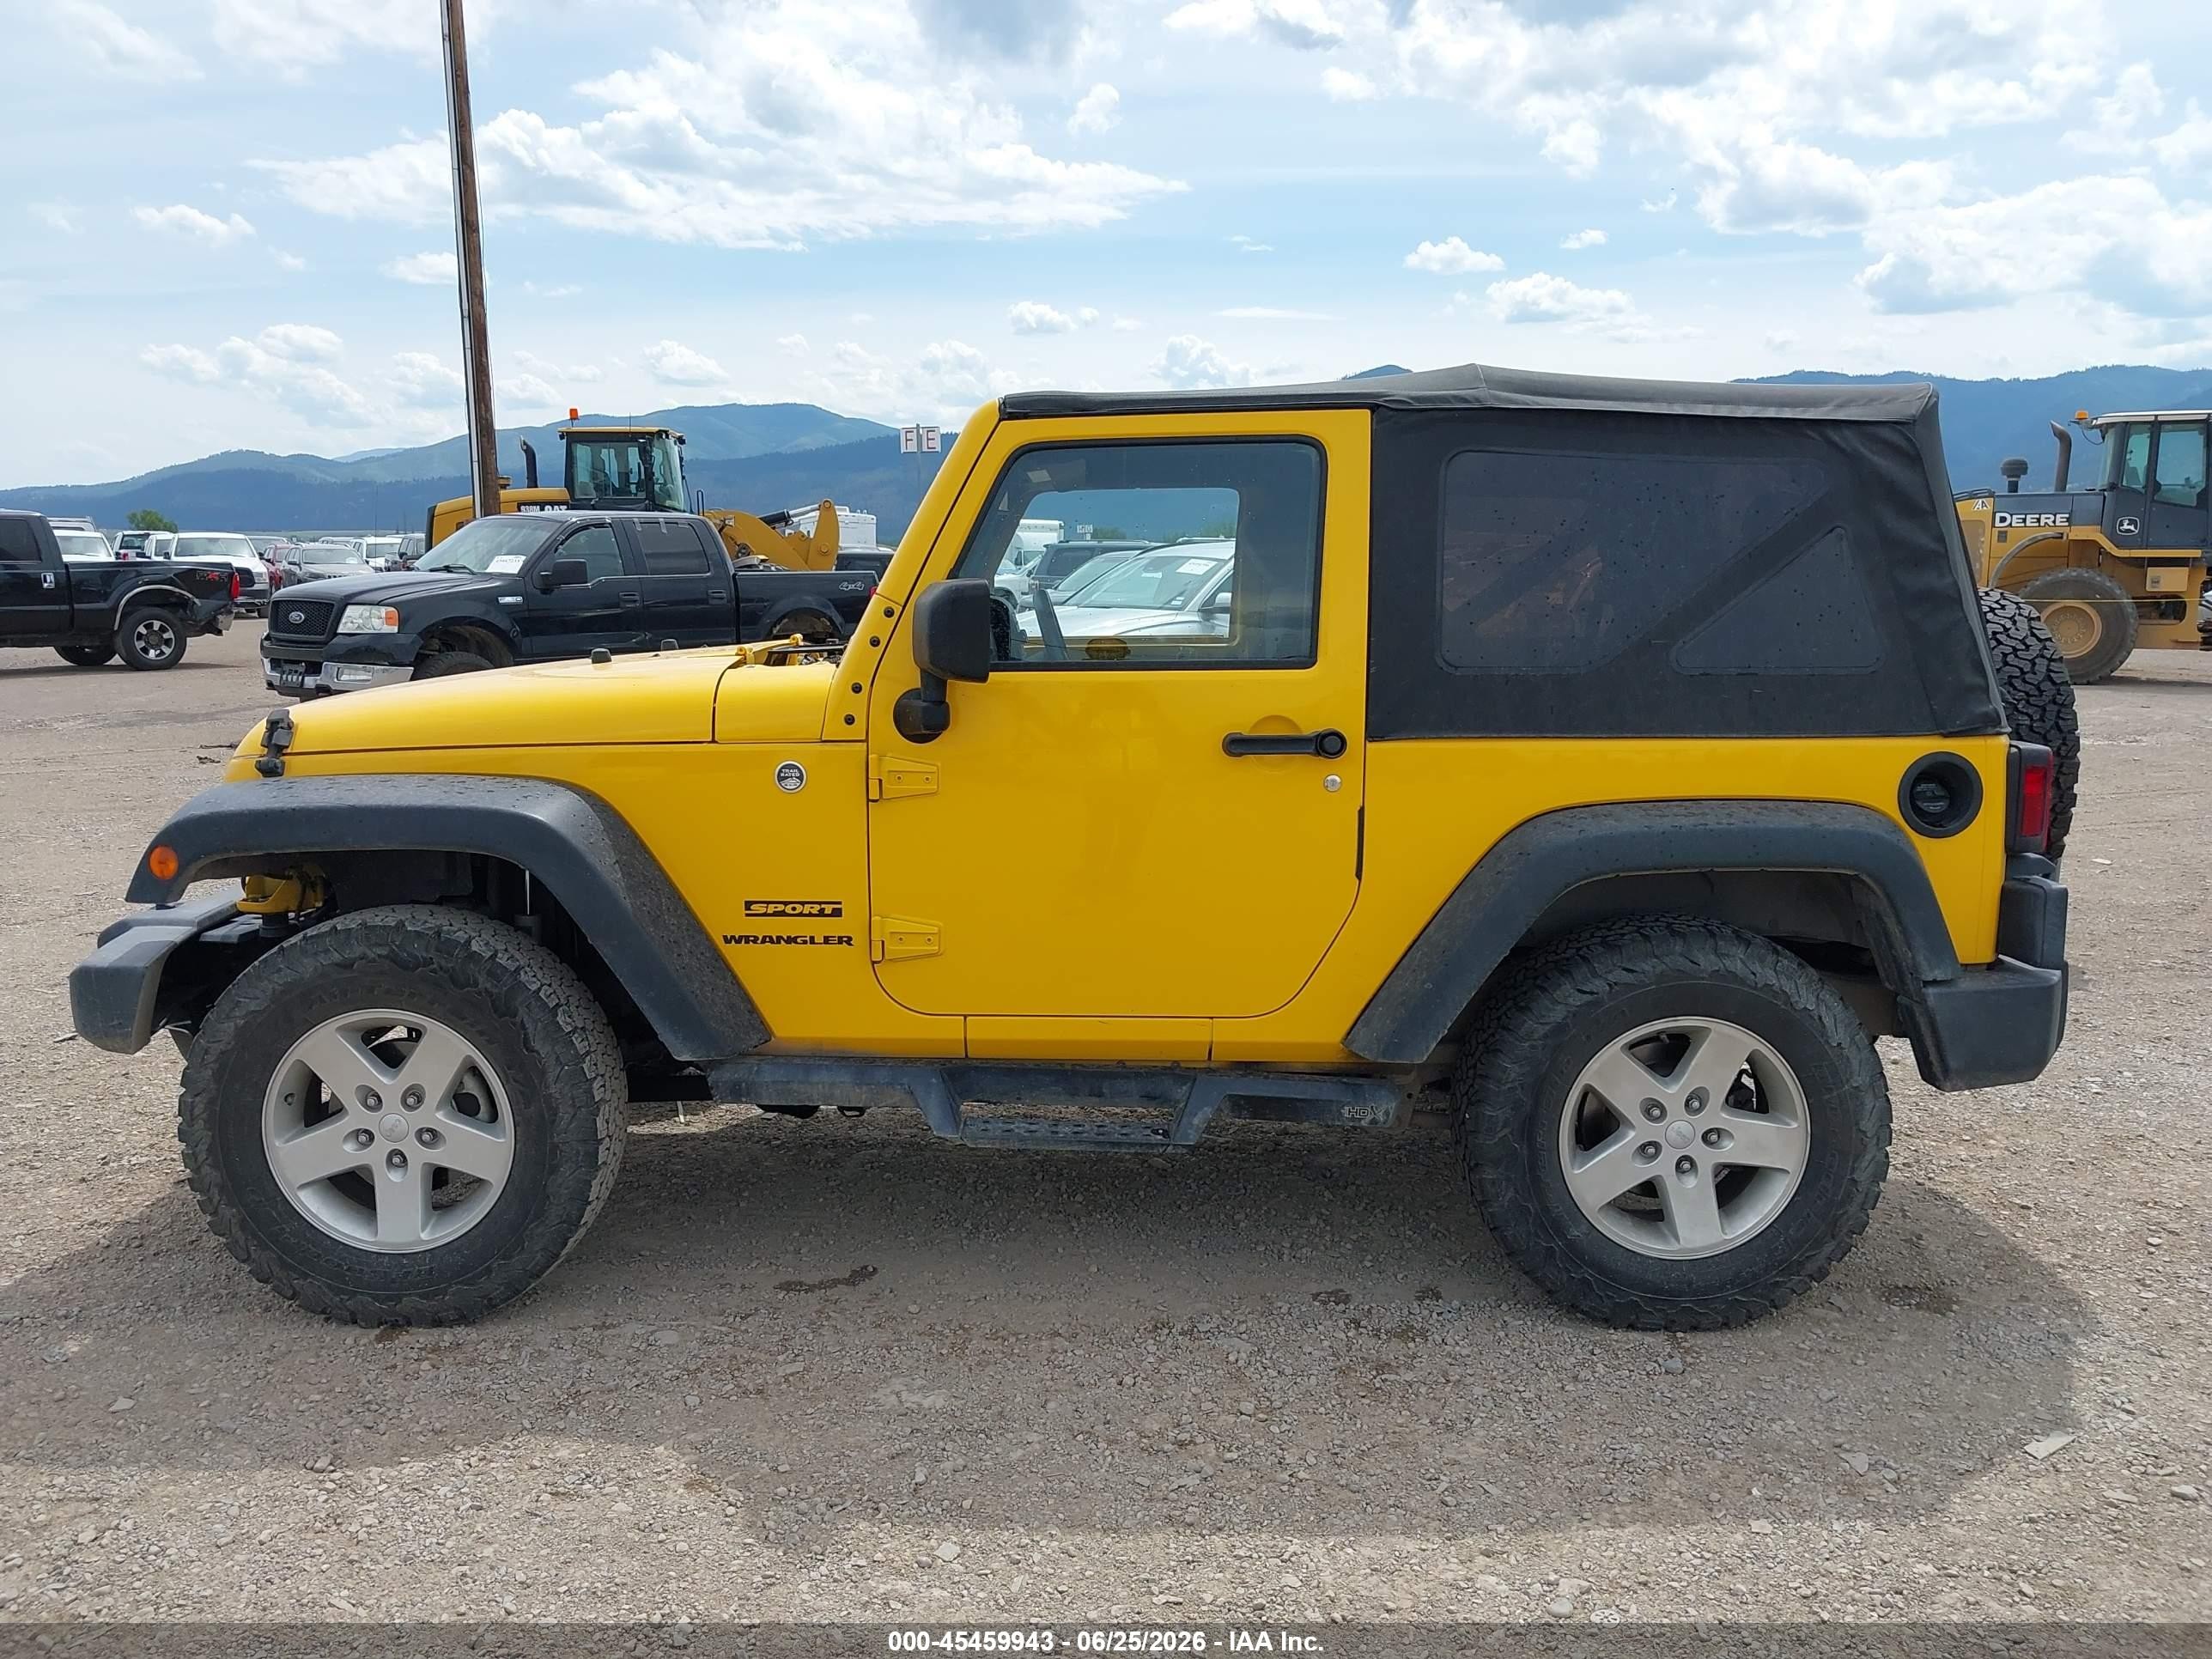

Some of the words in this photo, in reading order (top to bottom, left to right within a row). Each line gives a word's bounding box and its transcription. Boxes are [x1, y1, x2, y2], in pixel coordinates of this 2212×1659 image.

[905, 430, 915, 450] F
[927, 429, 937, 449] E
[1995, 513, 2069, 527] DEERE
[750, 902, 836, 915] SPORT
[722, 934, 854, 946] WRANGLER
